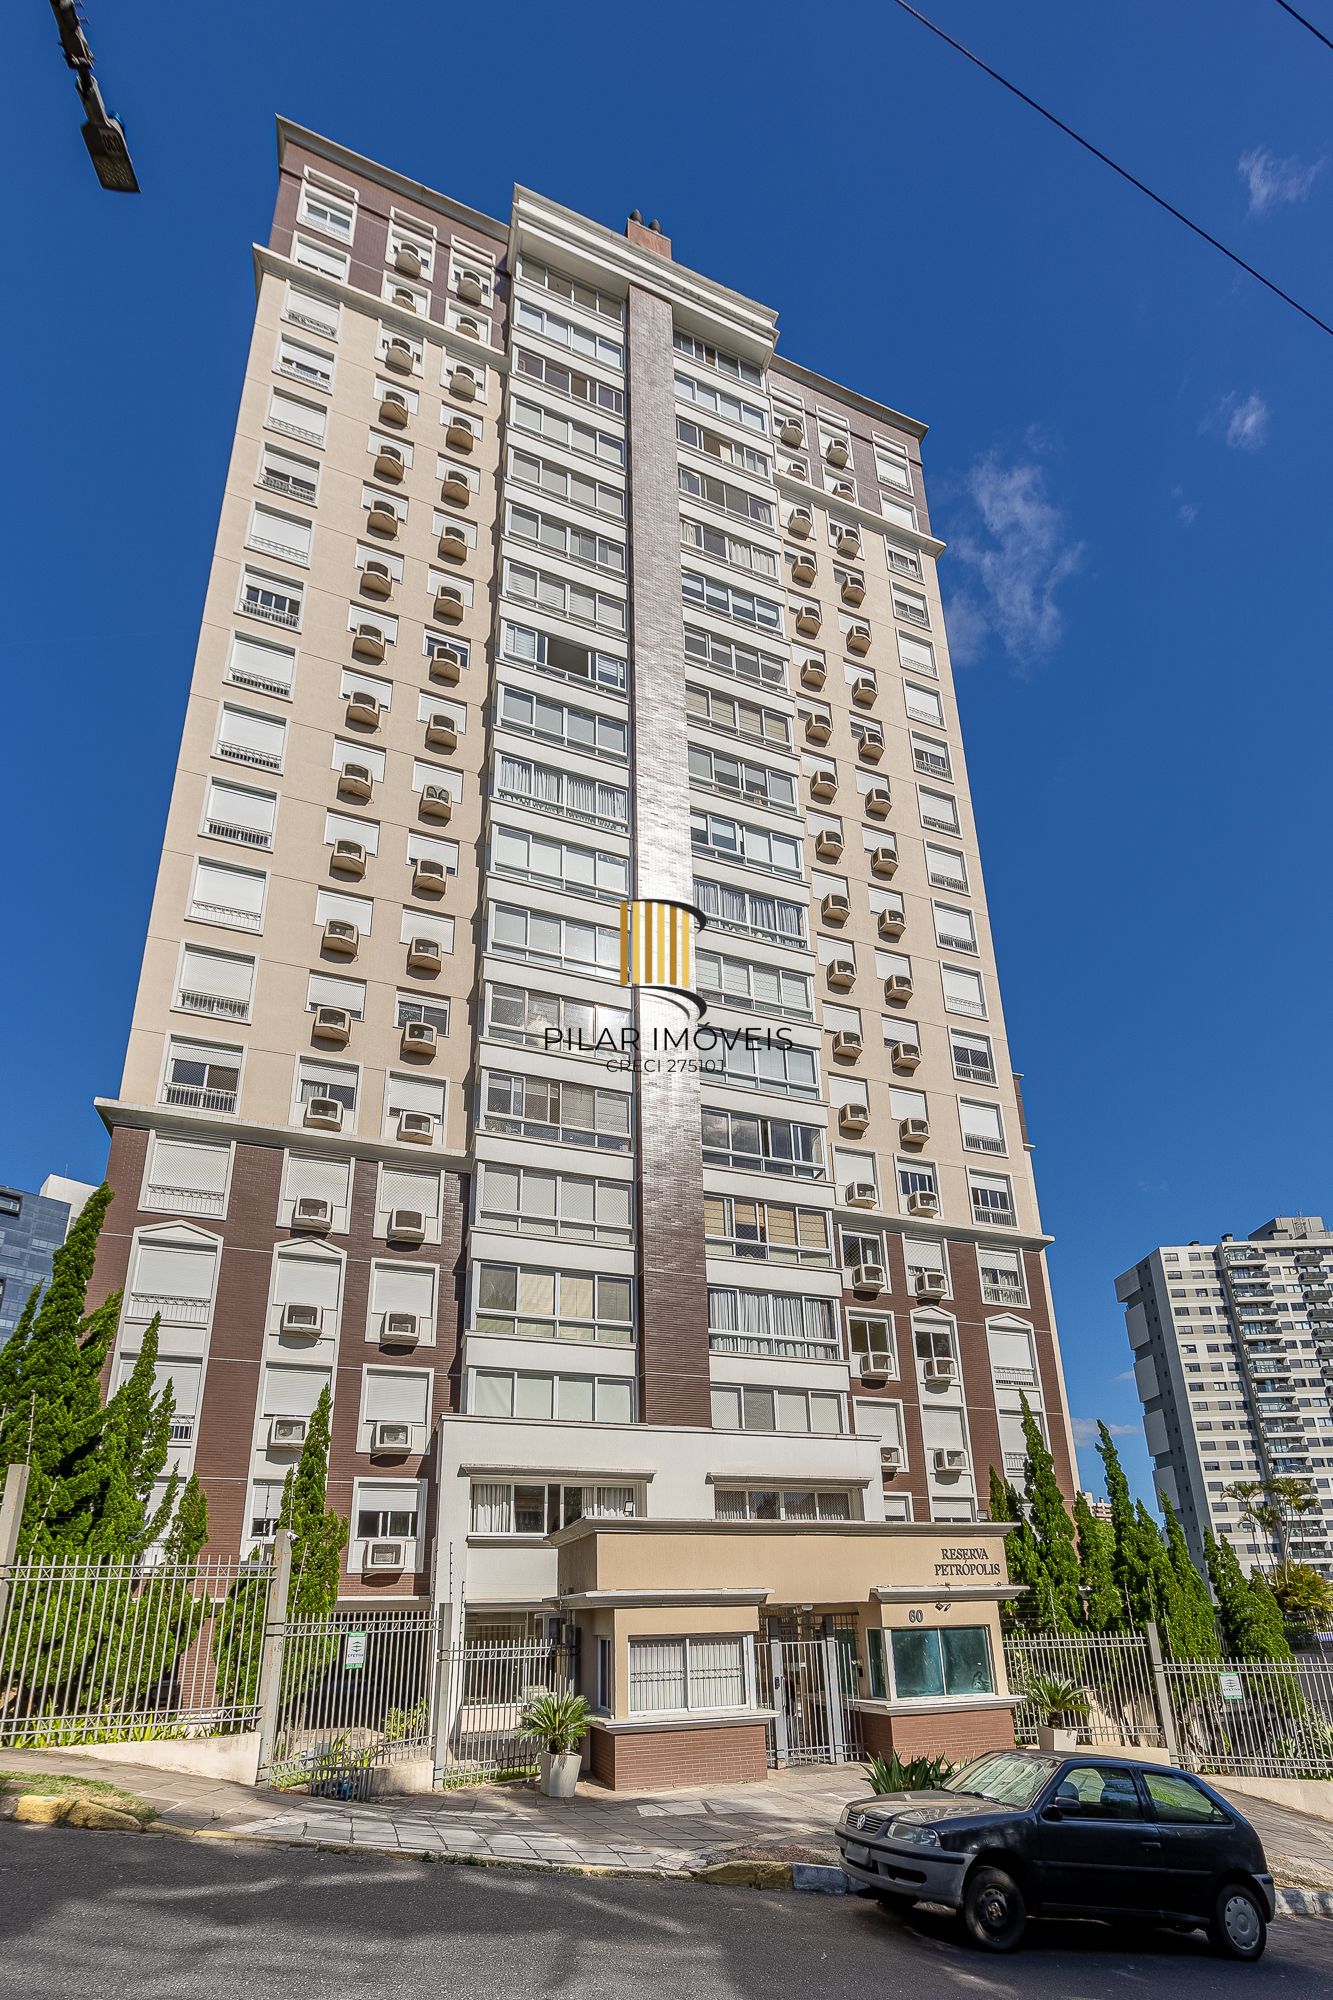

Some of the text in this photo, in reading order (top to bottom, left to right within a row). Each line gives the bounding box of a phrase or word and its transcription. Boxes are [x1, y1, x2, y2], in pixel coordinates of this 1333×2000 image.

[941, 1548, 989, 1560] RESERVA
[934, 1560, 1000, 1576] PETRÓPOLIS
[908, 1609, 923, 1623] 60
